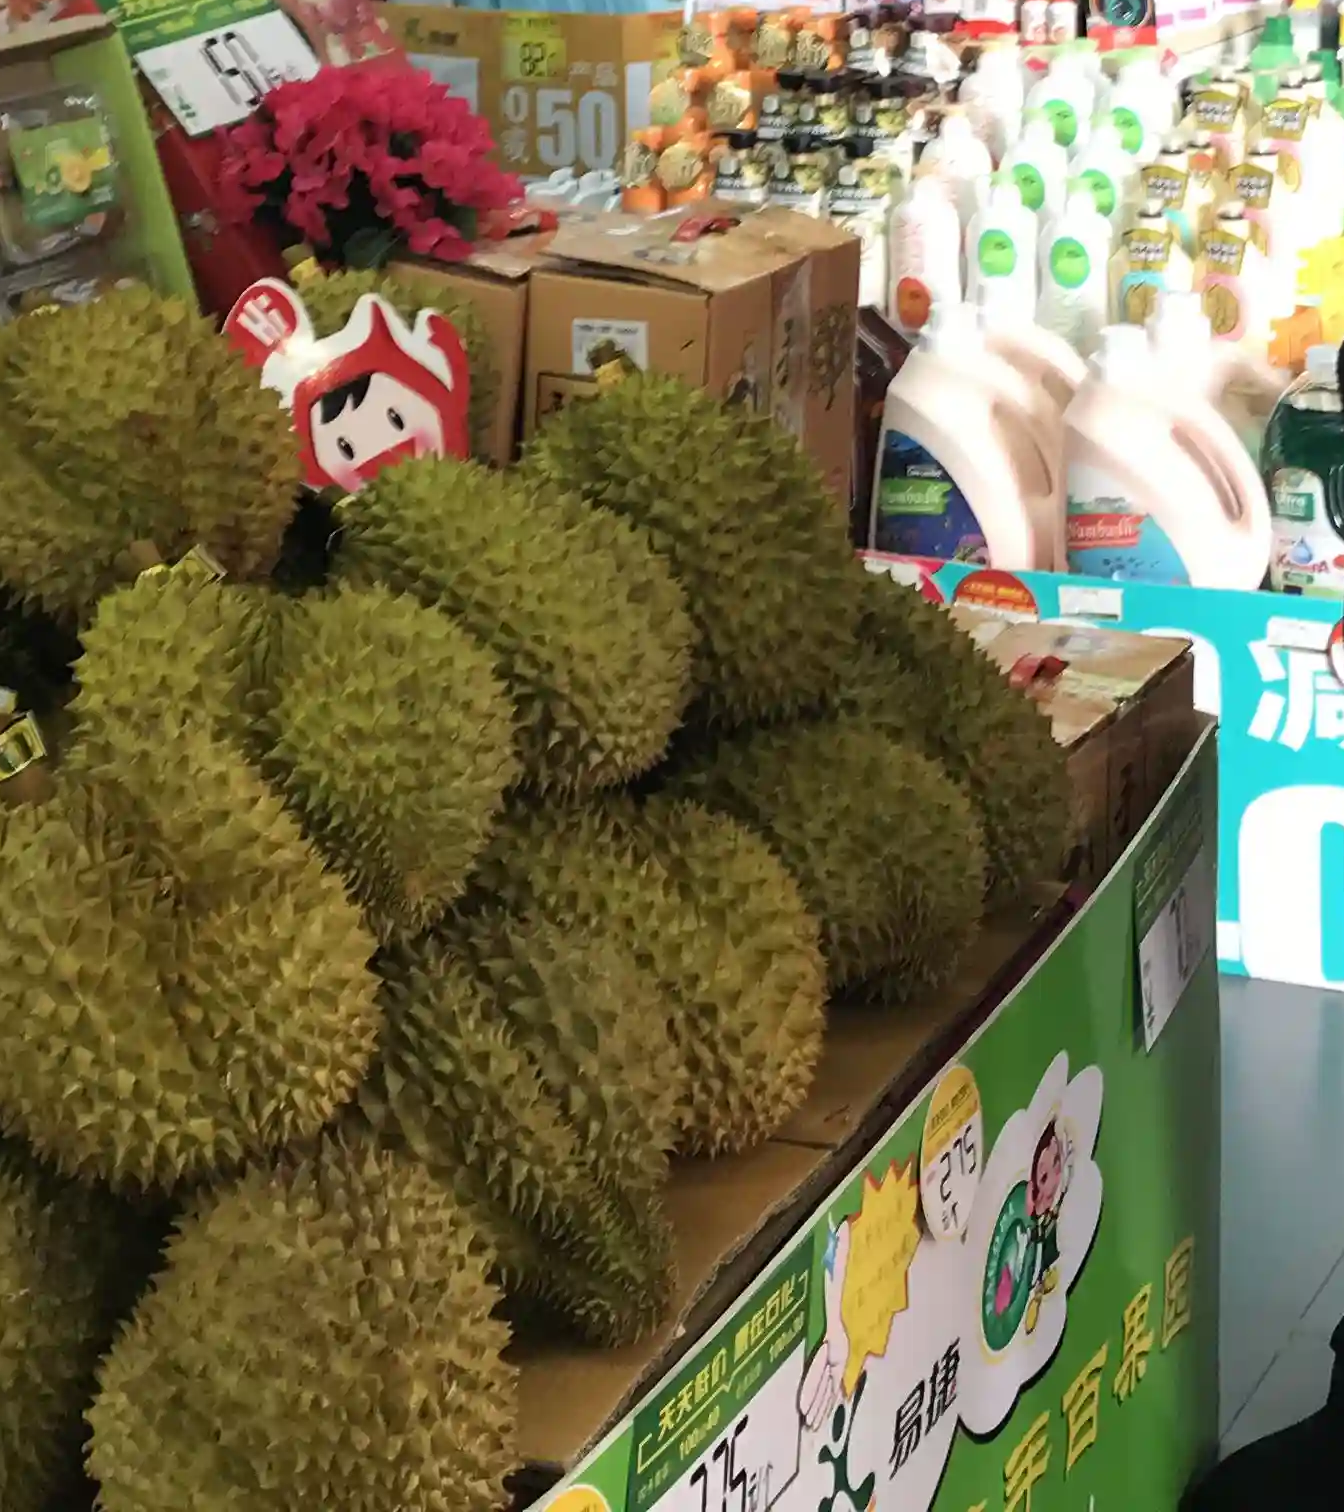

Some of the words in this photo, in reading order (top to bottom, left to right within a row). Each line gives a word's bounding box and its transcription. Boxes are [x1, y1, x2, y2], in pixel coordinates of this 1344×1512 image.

[536, 88, 616, 171] 50
[939, 1124, 977, 1203] 275
[888, 1336, 960, 1481] 易捷
[968, 1236, 1194, 1512] 手百果园
